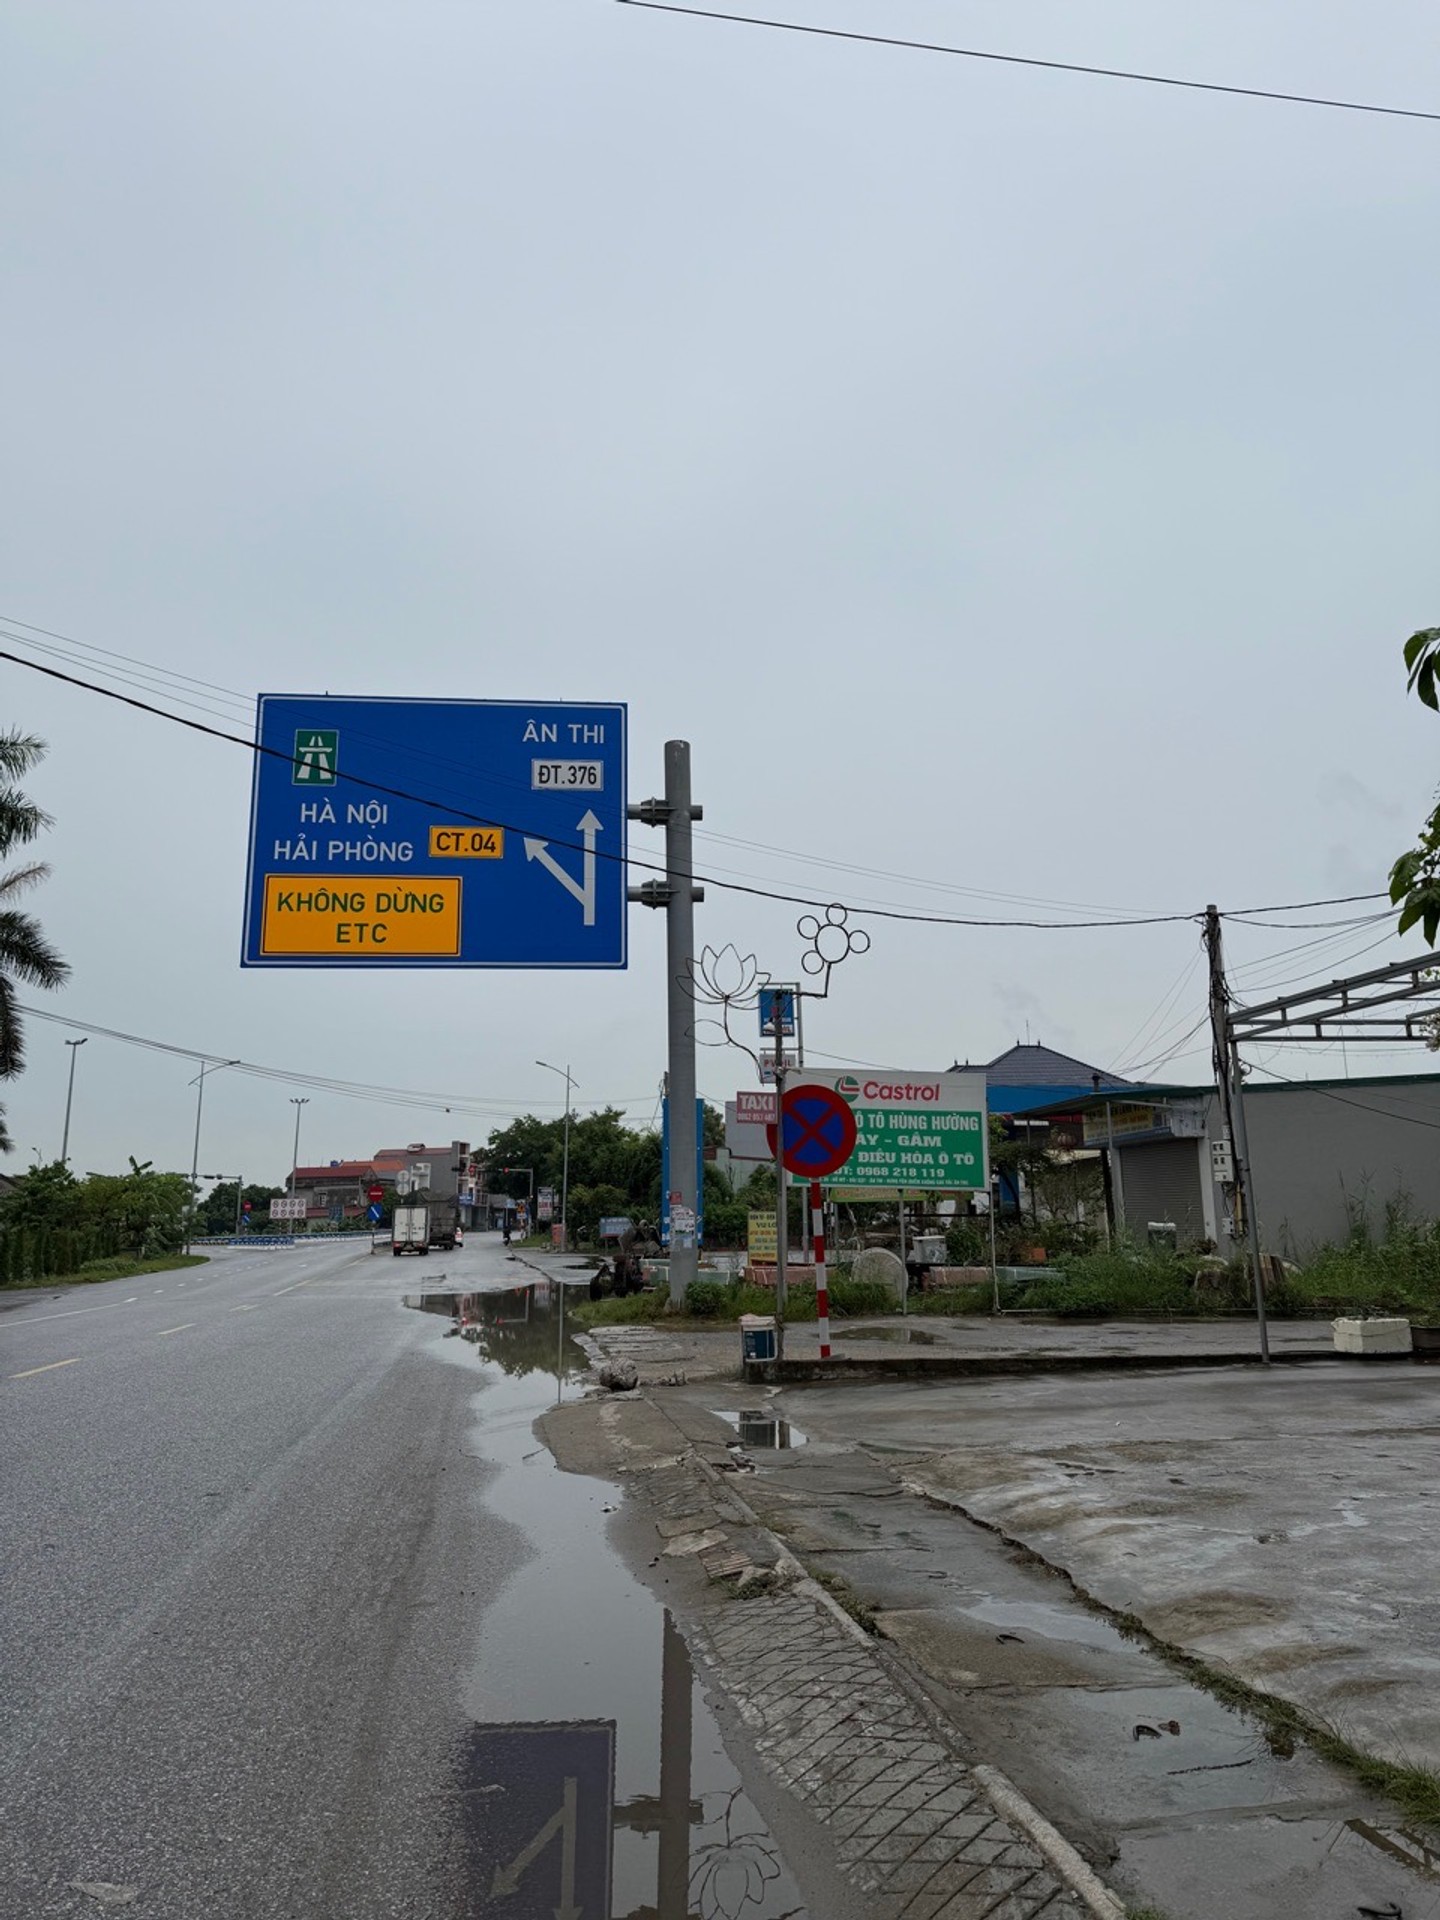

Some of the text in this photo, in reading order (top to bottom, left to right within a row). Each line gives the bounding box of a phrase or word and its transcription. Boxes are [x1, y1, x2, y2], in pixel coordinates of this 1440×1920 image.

[522, 719, 605, 744] ÂN THI
[538, 765, 597, 785] ĐT.376
[301, 797, 388, 829] HÀ NỘI
[273, 833, 413, 862] HẢI PHÒNG
[436, 832, 496, 853] CT.04
[277, 887, 444, 913] KHÔNG DỪNG
[336, 922, 388, 943] ETC
[863, 1081, 940, 1101] Castrol
[740, 1094, 774, 1110] TAXI
[868, 1112, 885, 1129] TÔ
[889, 1112, 927, 1130] HÙNG
[953, 1153, 975, 1165] TÔ
[856, 1167, 889, 1176] 0968
[893, 1168, 917, 1178] 218
[921, 1169, 945, 1178] 119
